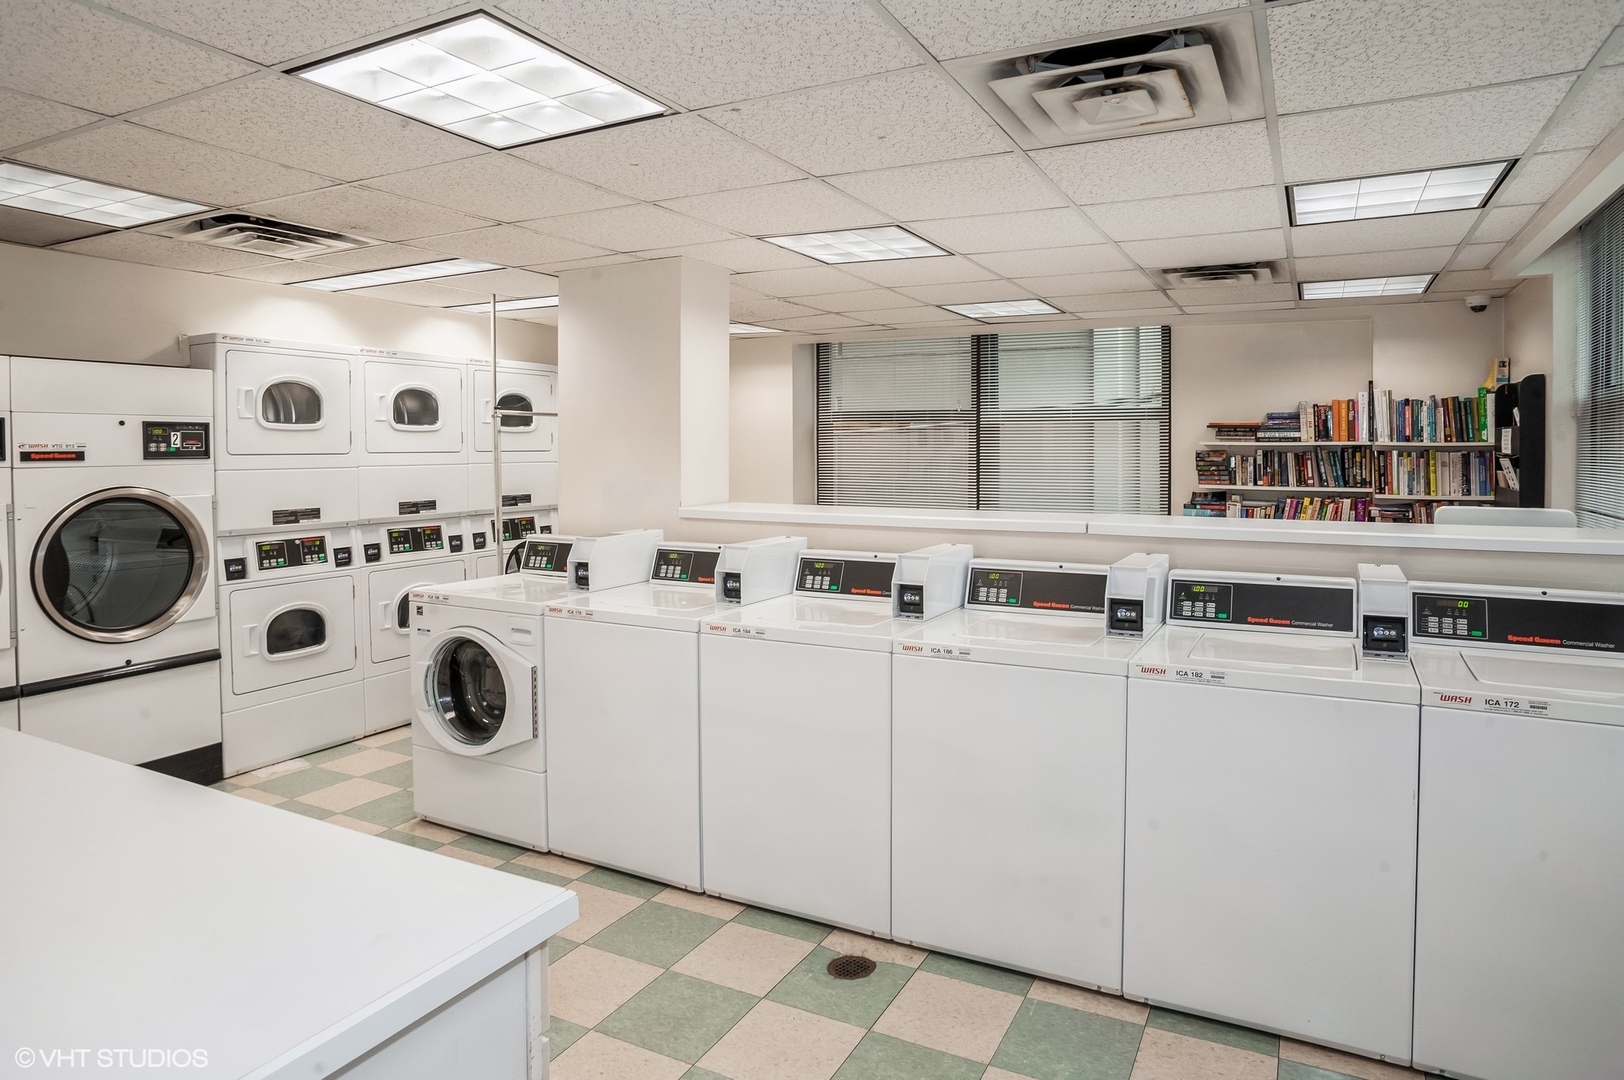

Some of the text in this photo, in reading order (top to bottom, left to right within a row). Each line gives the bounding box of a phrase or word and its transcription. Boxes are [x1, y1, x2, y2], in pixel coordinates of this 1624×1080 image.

[172, 433, 179, 446] 2
[1507, 634, 1534, 643] Speed
[1534, 636, 1561, 645] Queen
[1562, 639, 1594, 647] Commercial
[902, 645, 924, 653] WASH
[1140, 666, 1167, 676] WASH
[1191, 671, 1204, 679] 182
[1439, 694, 1473, 704] WASH
[1484, 698, 1501, 707] ICA
[1503, 700, 1520, 709] 172
